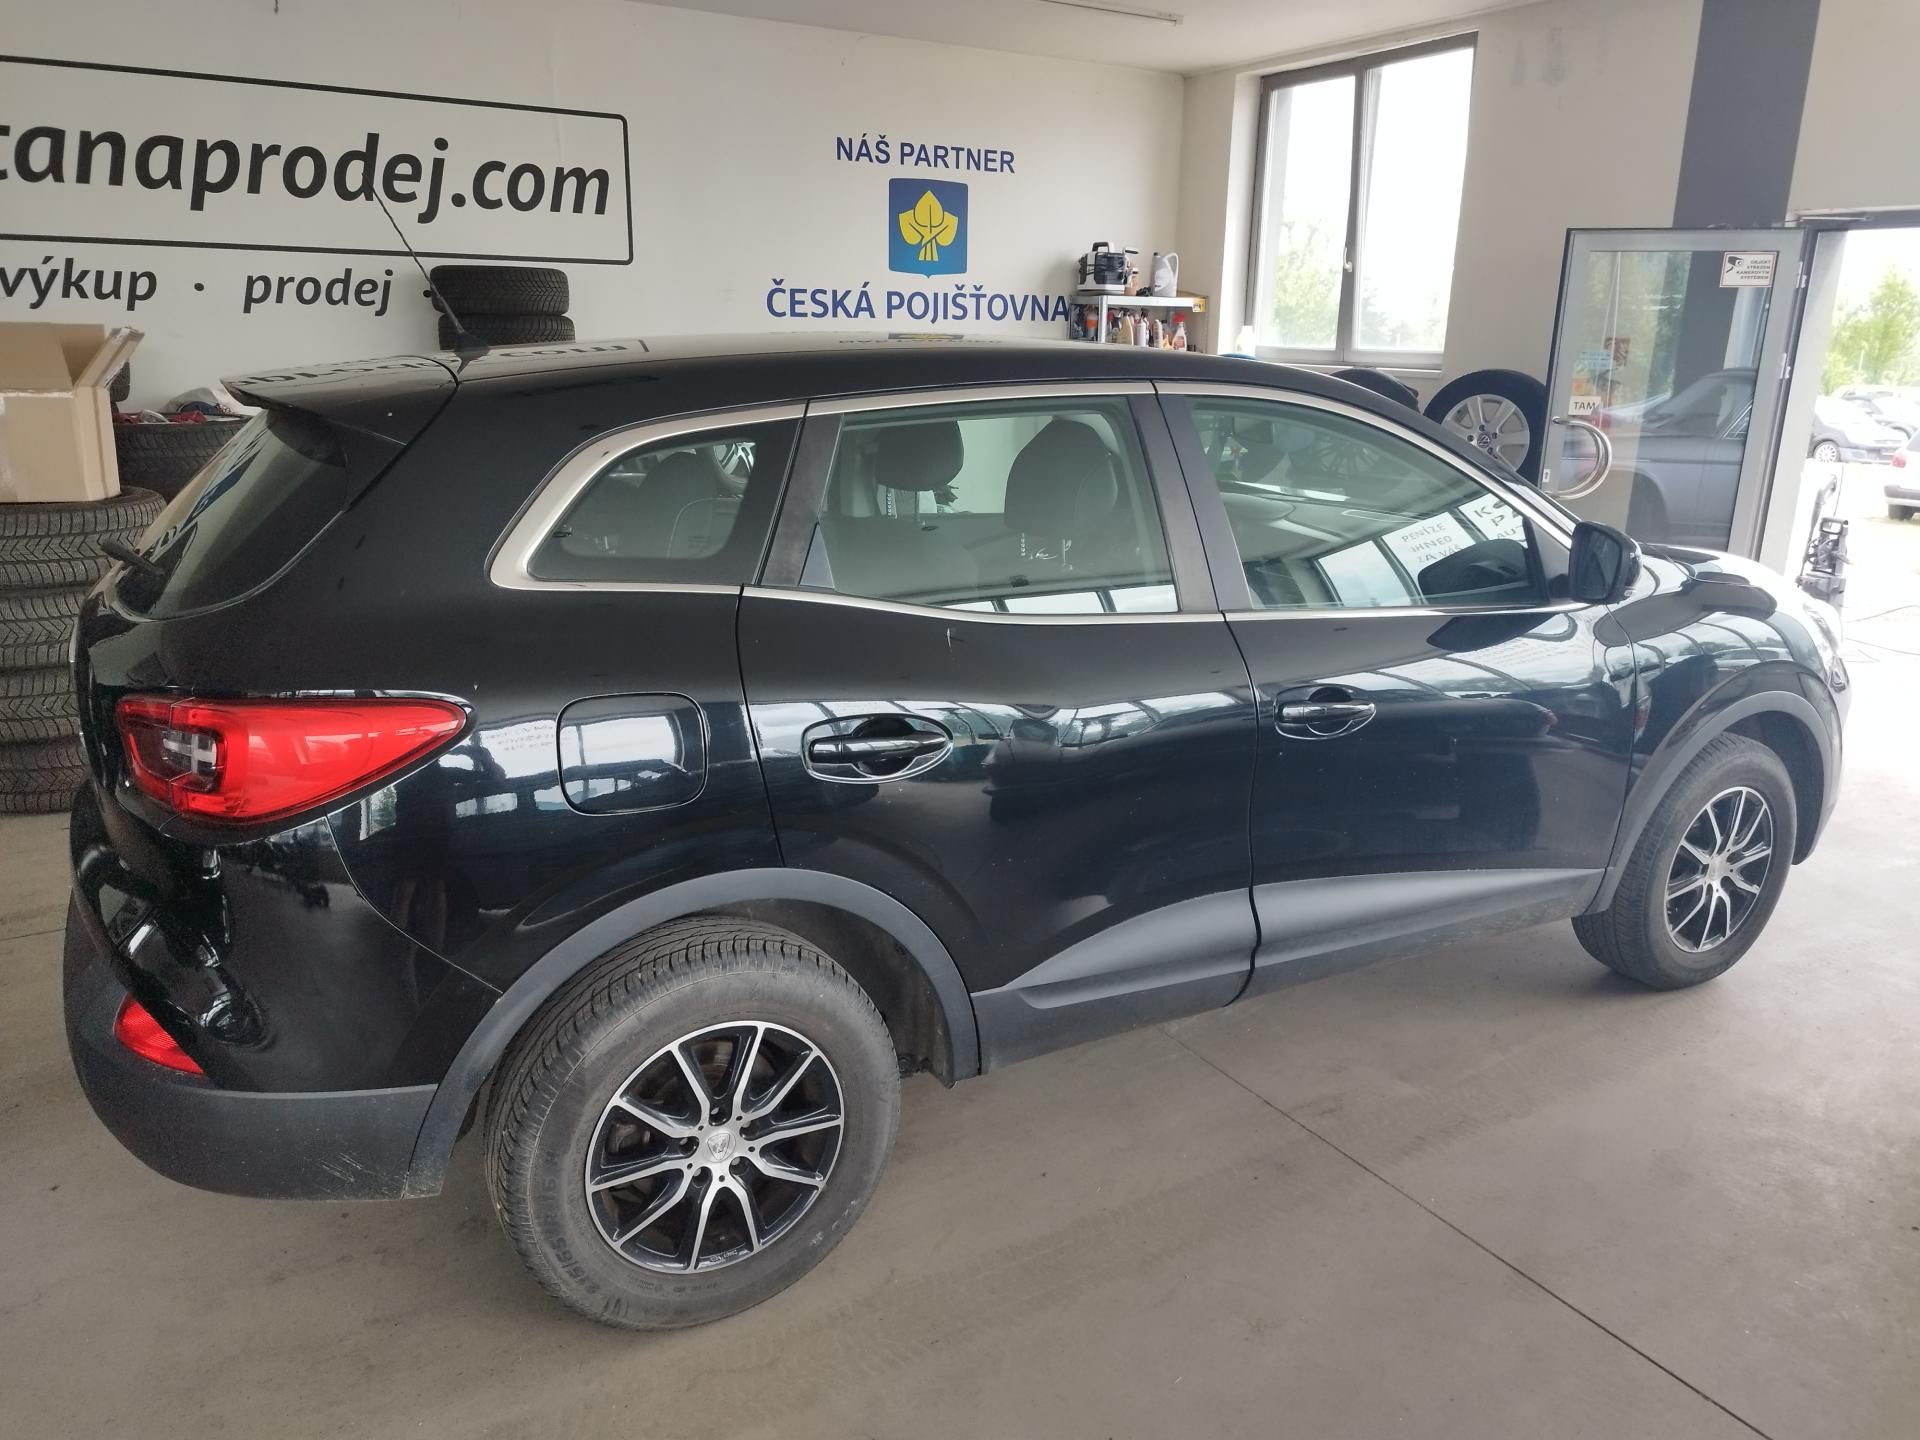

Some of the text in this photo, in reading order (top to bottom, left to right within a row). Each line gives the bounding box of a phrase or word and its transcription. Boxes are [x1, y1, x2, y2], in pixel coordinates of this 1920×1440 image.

[836, 133, 1016, 173] NÁŠ PARTNER
[0, 256, 394, 317] výkup prodej
[766, 278, 1071, 325] ČESKÁ POJIŠŤOVNA
